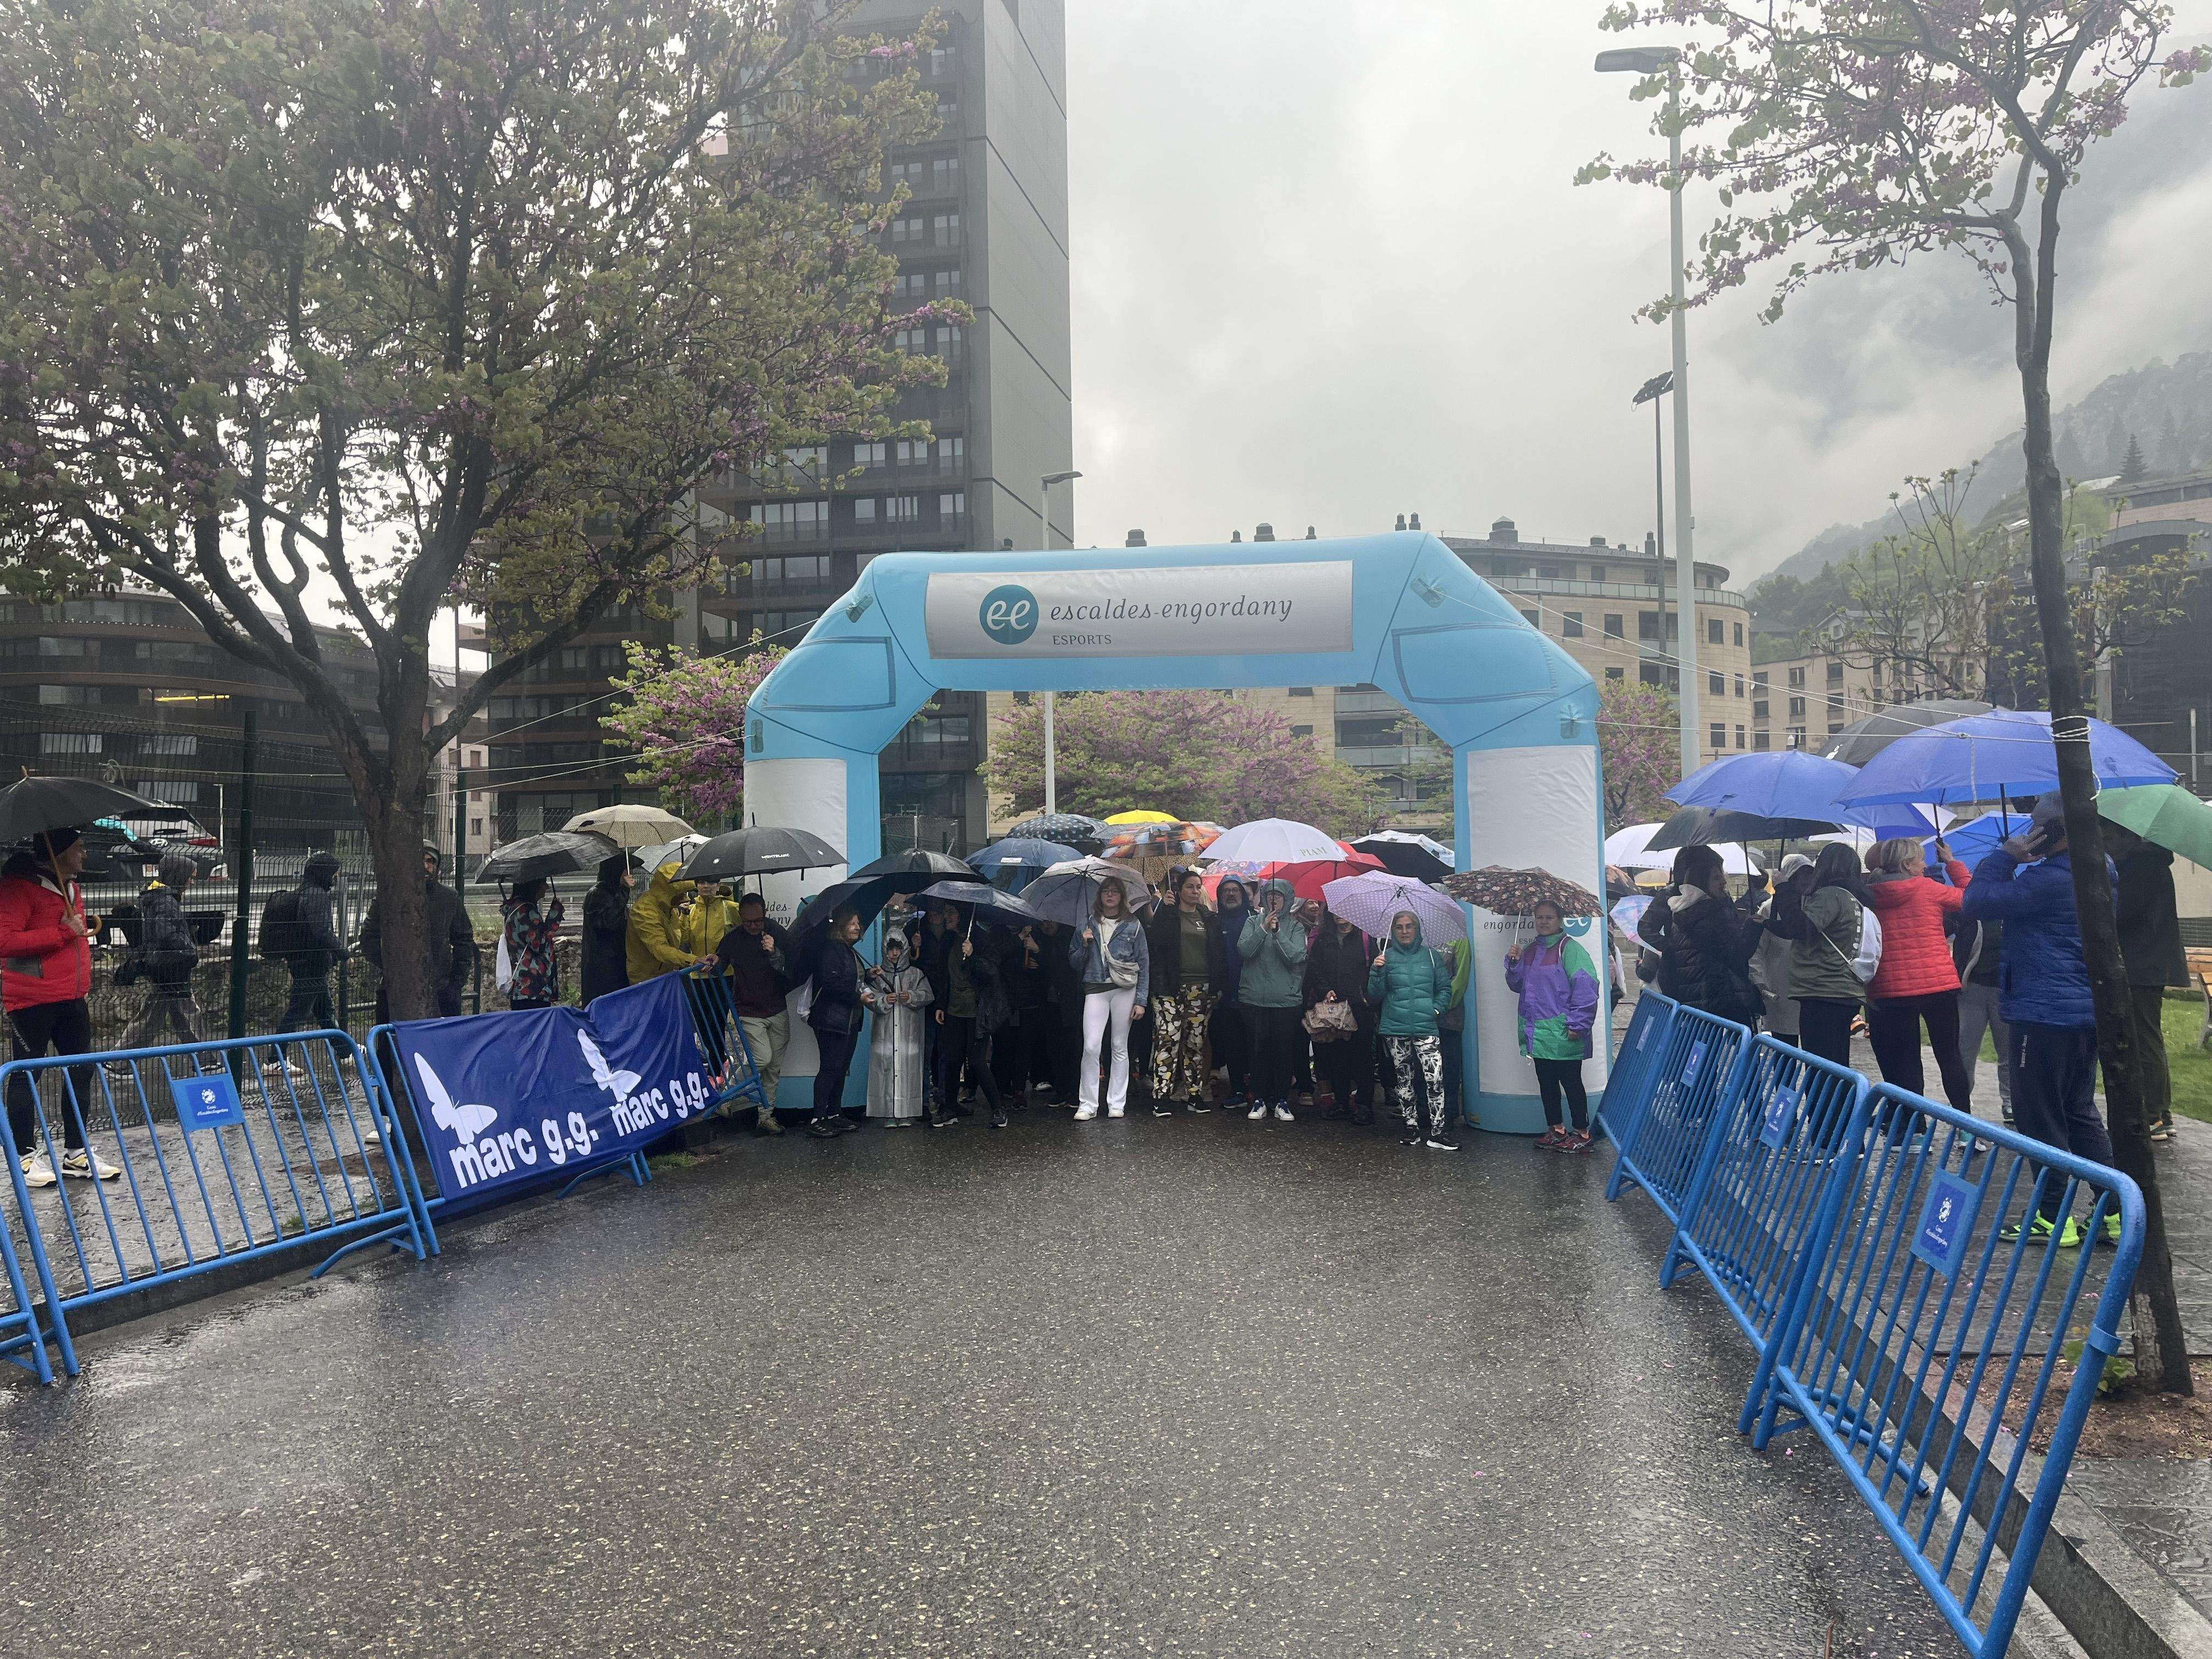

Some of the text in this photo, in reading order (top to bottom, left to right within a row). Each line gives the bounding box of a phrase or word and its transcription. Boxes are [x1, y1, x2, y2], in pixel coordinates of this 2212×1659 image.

[986, 599, 1031, 630] ee
[1051, 595, 1293, 624] escaldes-engordany
[1052, 634, 1112, 645] ESPORTS
[1300, 847, 1328, 856] PIAM
[1484, 918, 1534, 933] engorda
[609, 1071, 709, 1137] marc g.g.
[449, 1111, 599, 1189] marc g.g.
